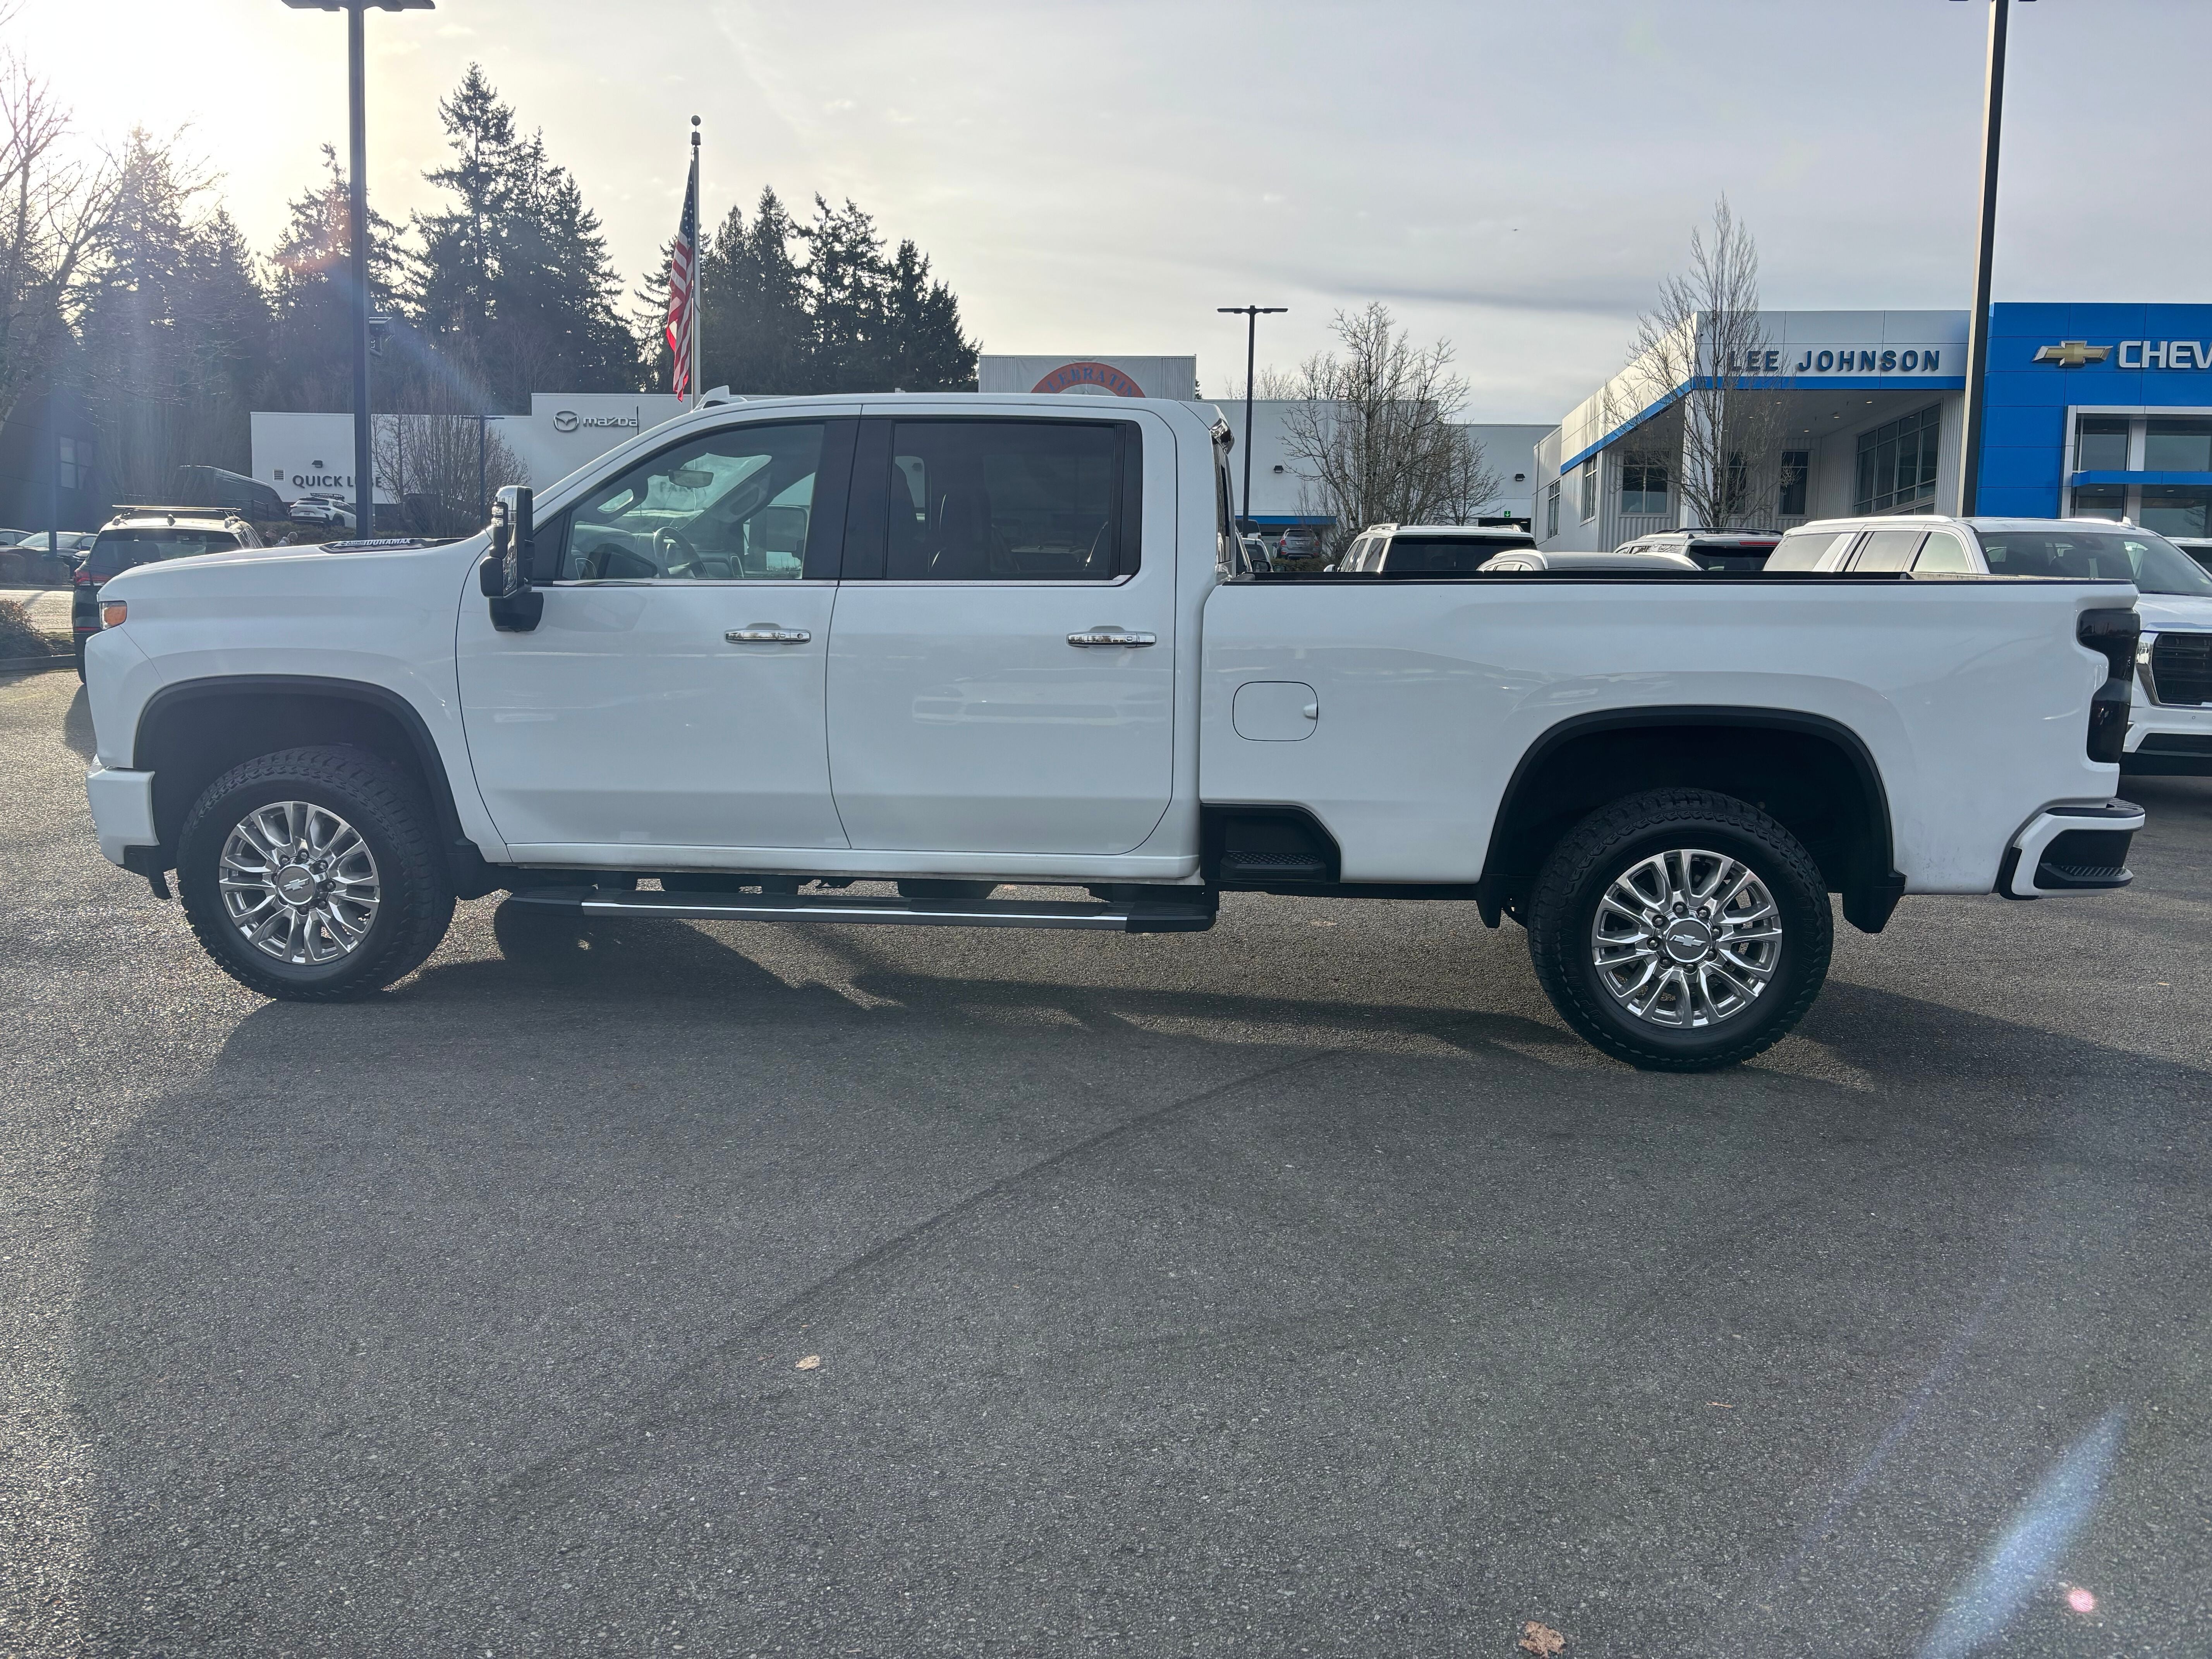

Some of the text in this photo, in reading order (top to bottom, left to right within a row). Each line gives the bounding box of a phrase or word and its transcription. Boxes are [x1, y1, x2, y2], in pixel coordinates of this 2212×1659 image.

[1730, 350, 1940, 371] LEE JOHNSON
[582, 416, 638, 427] mazda
[292, 475, 382, 488] QUICK LE
